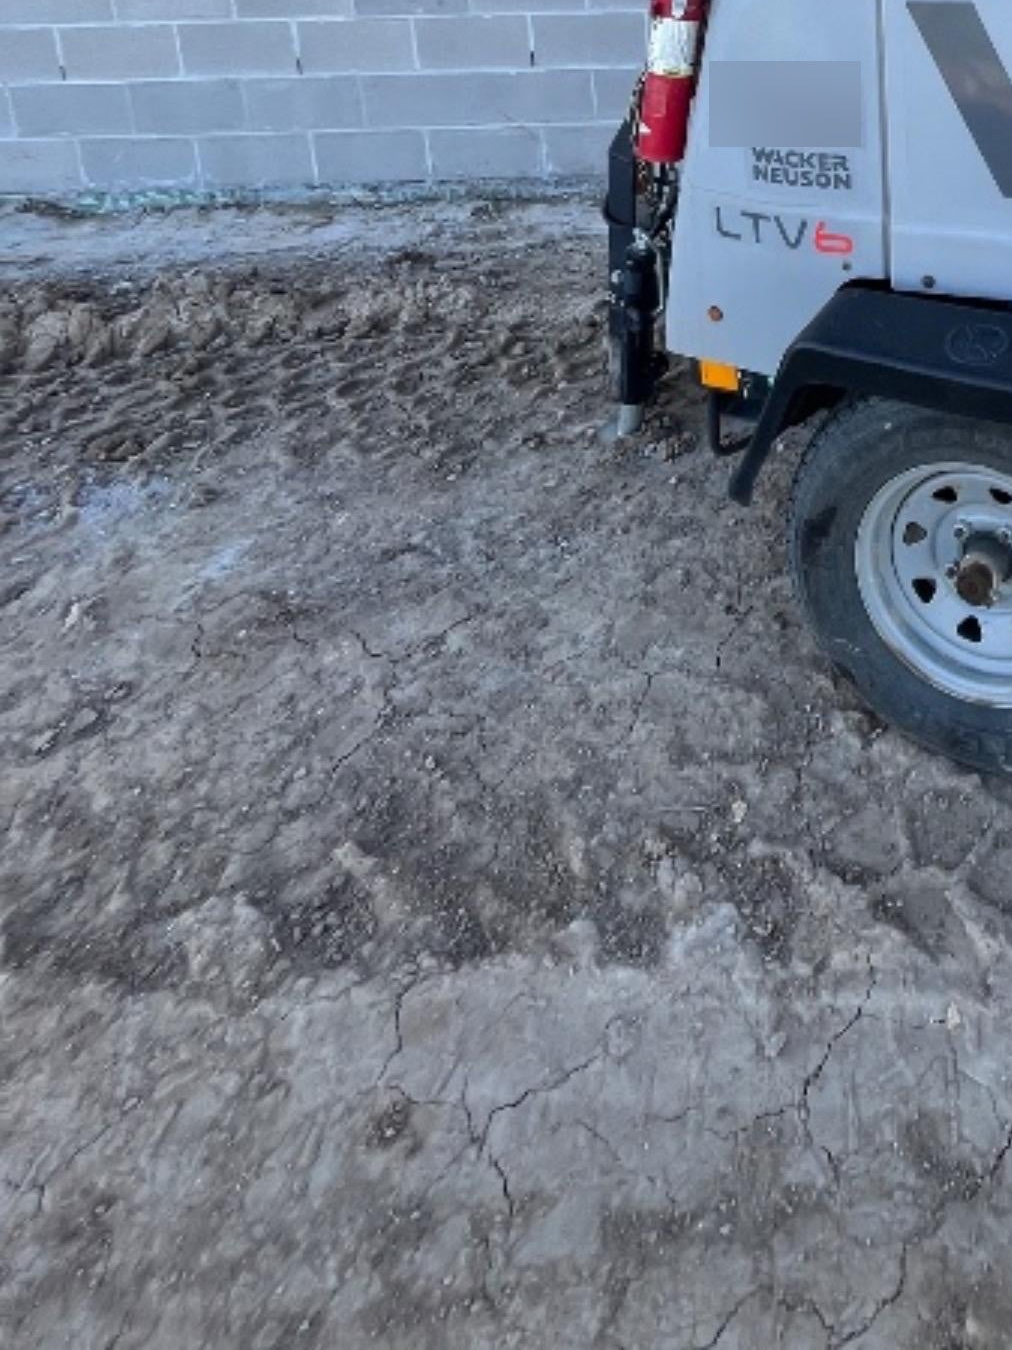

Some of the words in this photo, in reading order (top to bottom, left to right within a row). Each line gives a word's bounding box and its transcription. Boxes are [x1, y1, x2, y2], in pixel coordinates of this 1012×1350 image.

[752, 147, 849, 171] WACKER
[752, 164, 852, 189] NEUSON
[716, 206, 854, 254] LTV6
